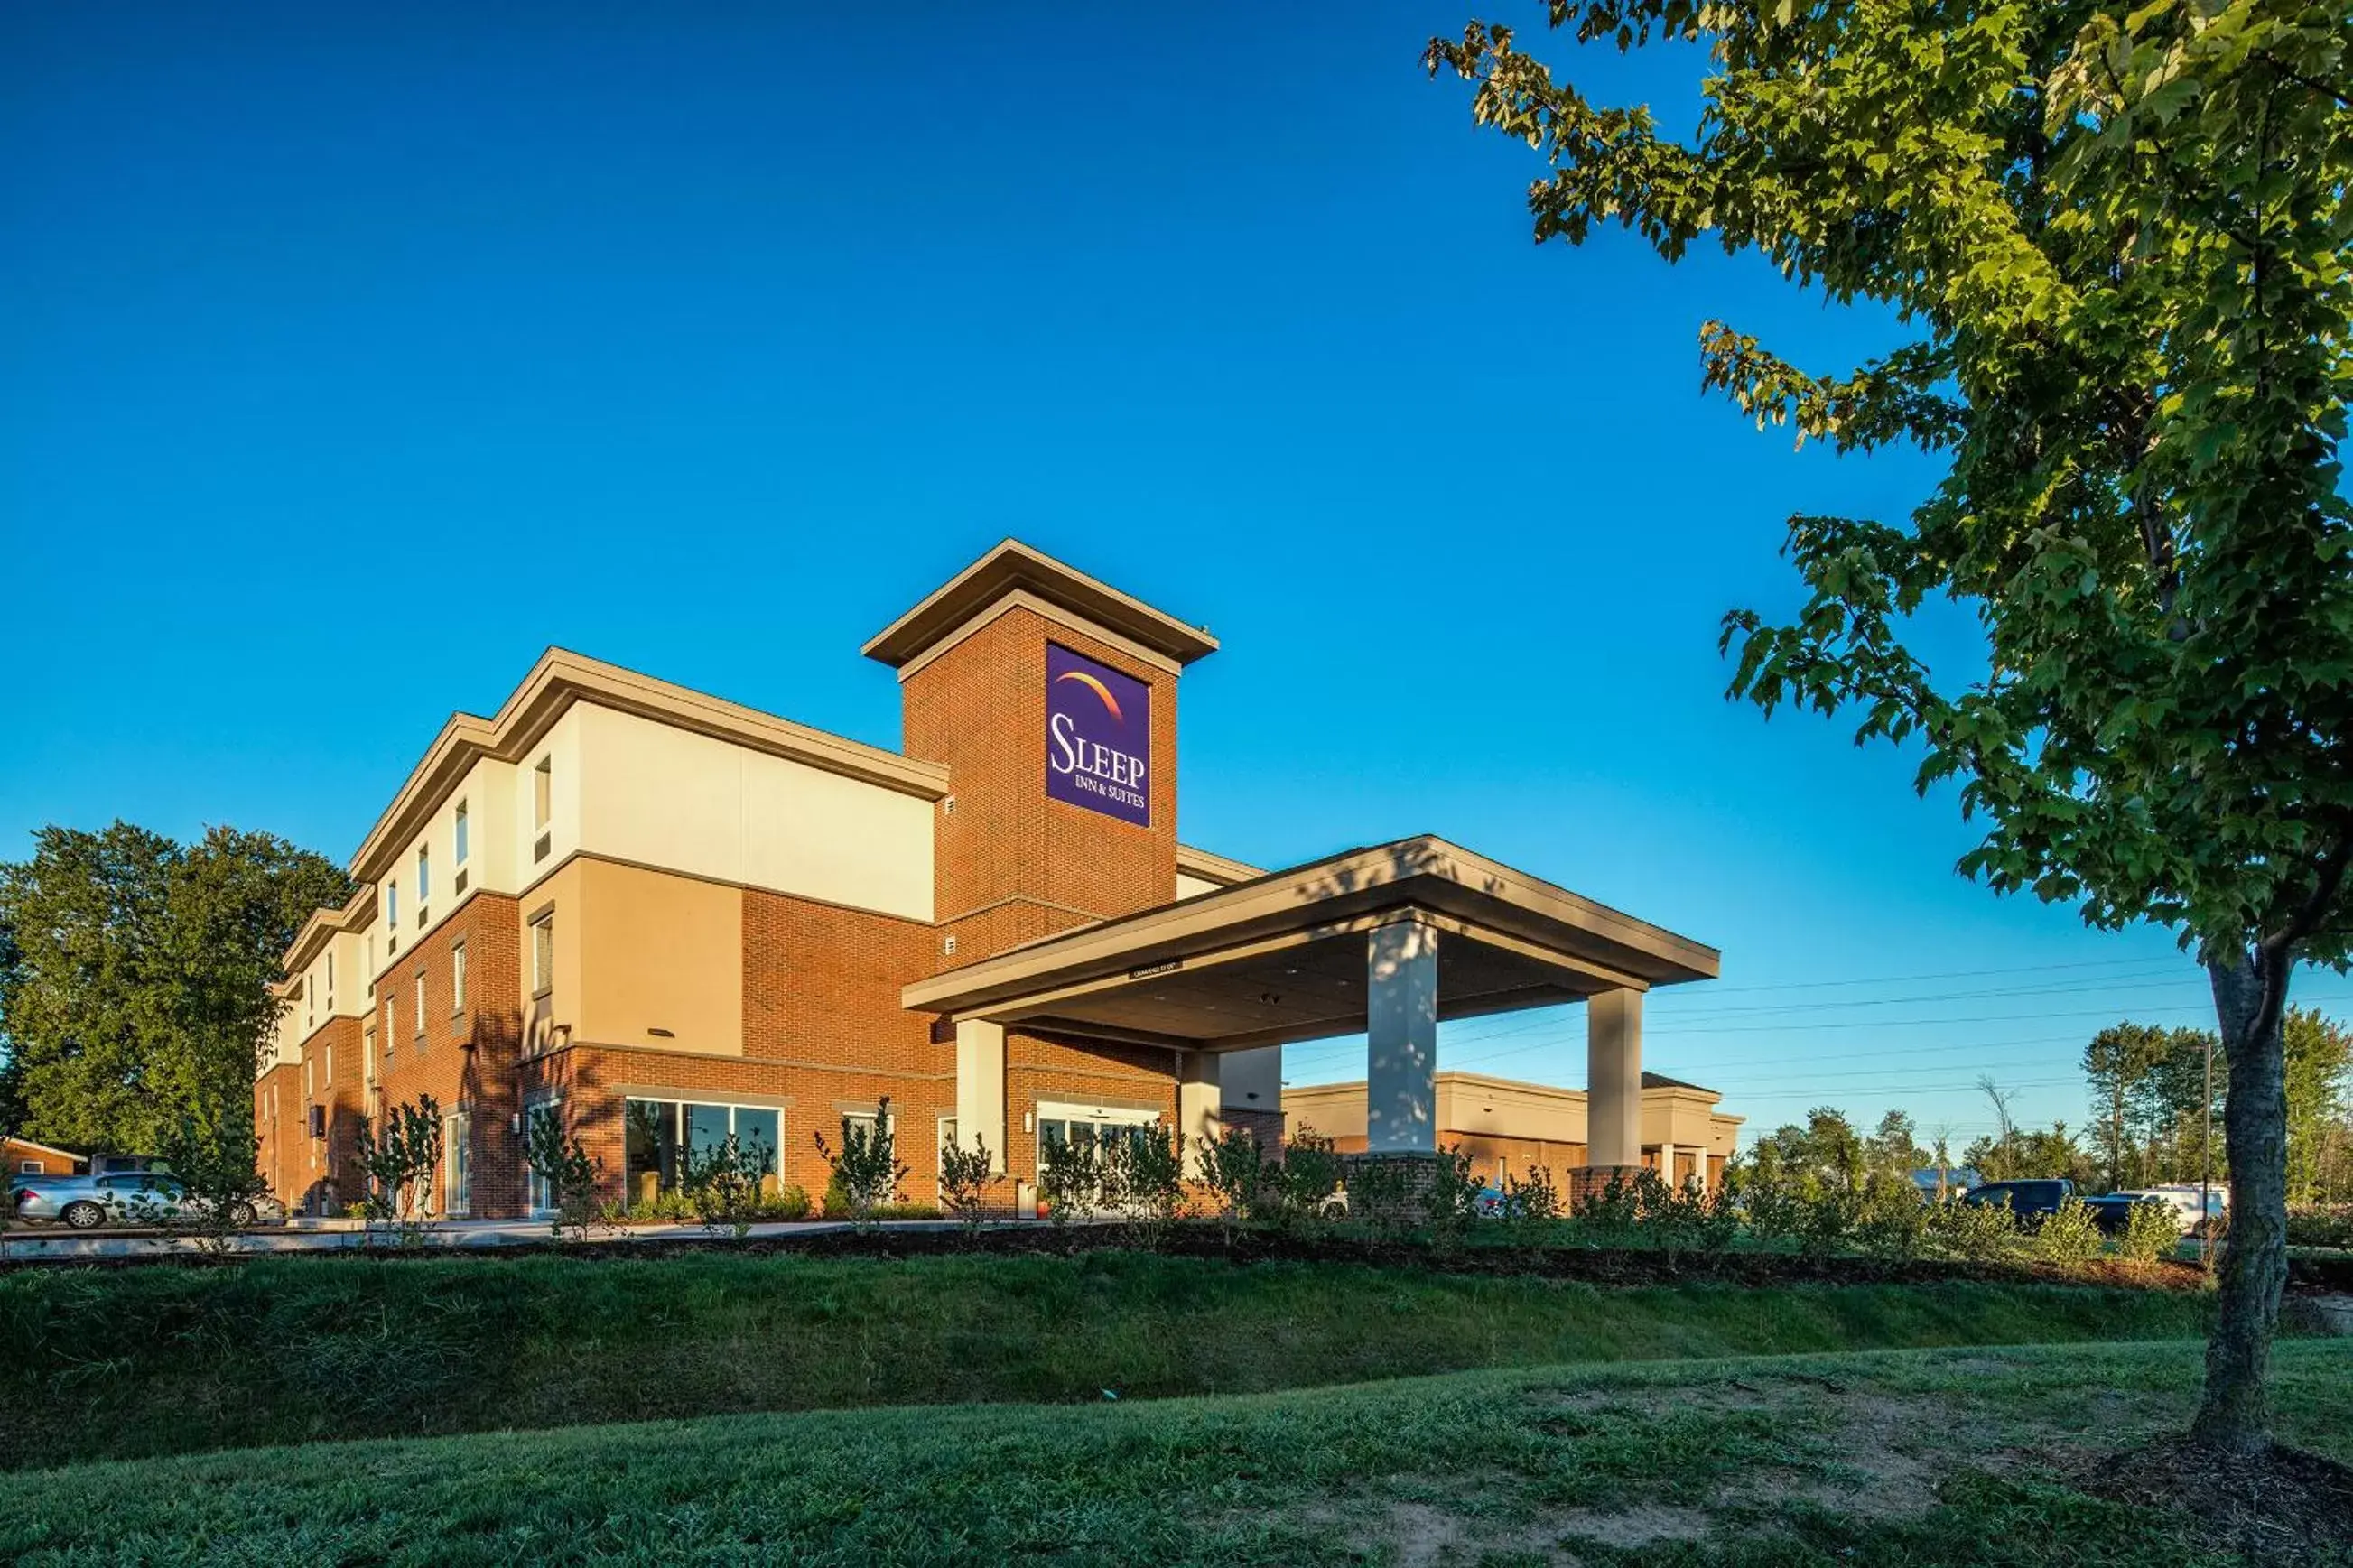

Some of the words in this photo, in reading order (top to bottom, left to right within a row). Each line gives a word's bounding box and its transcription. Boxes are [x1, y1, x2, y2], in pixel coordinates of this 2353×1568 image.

[1051, 712, 1144, 789] SLEEP
[1075, 775, 1097, 793] INN
[1099, 784, 1106, 796] &
[1109, 785, 1144, 808] SUITES
